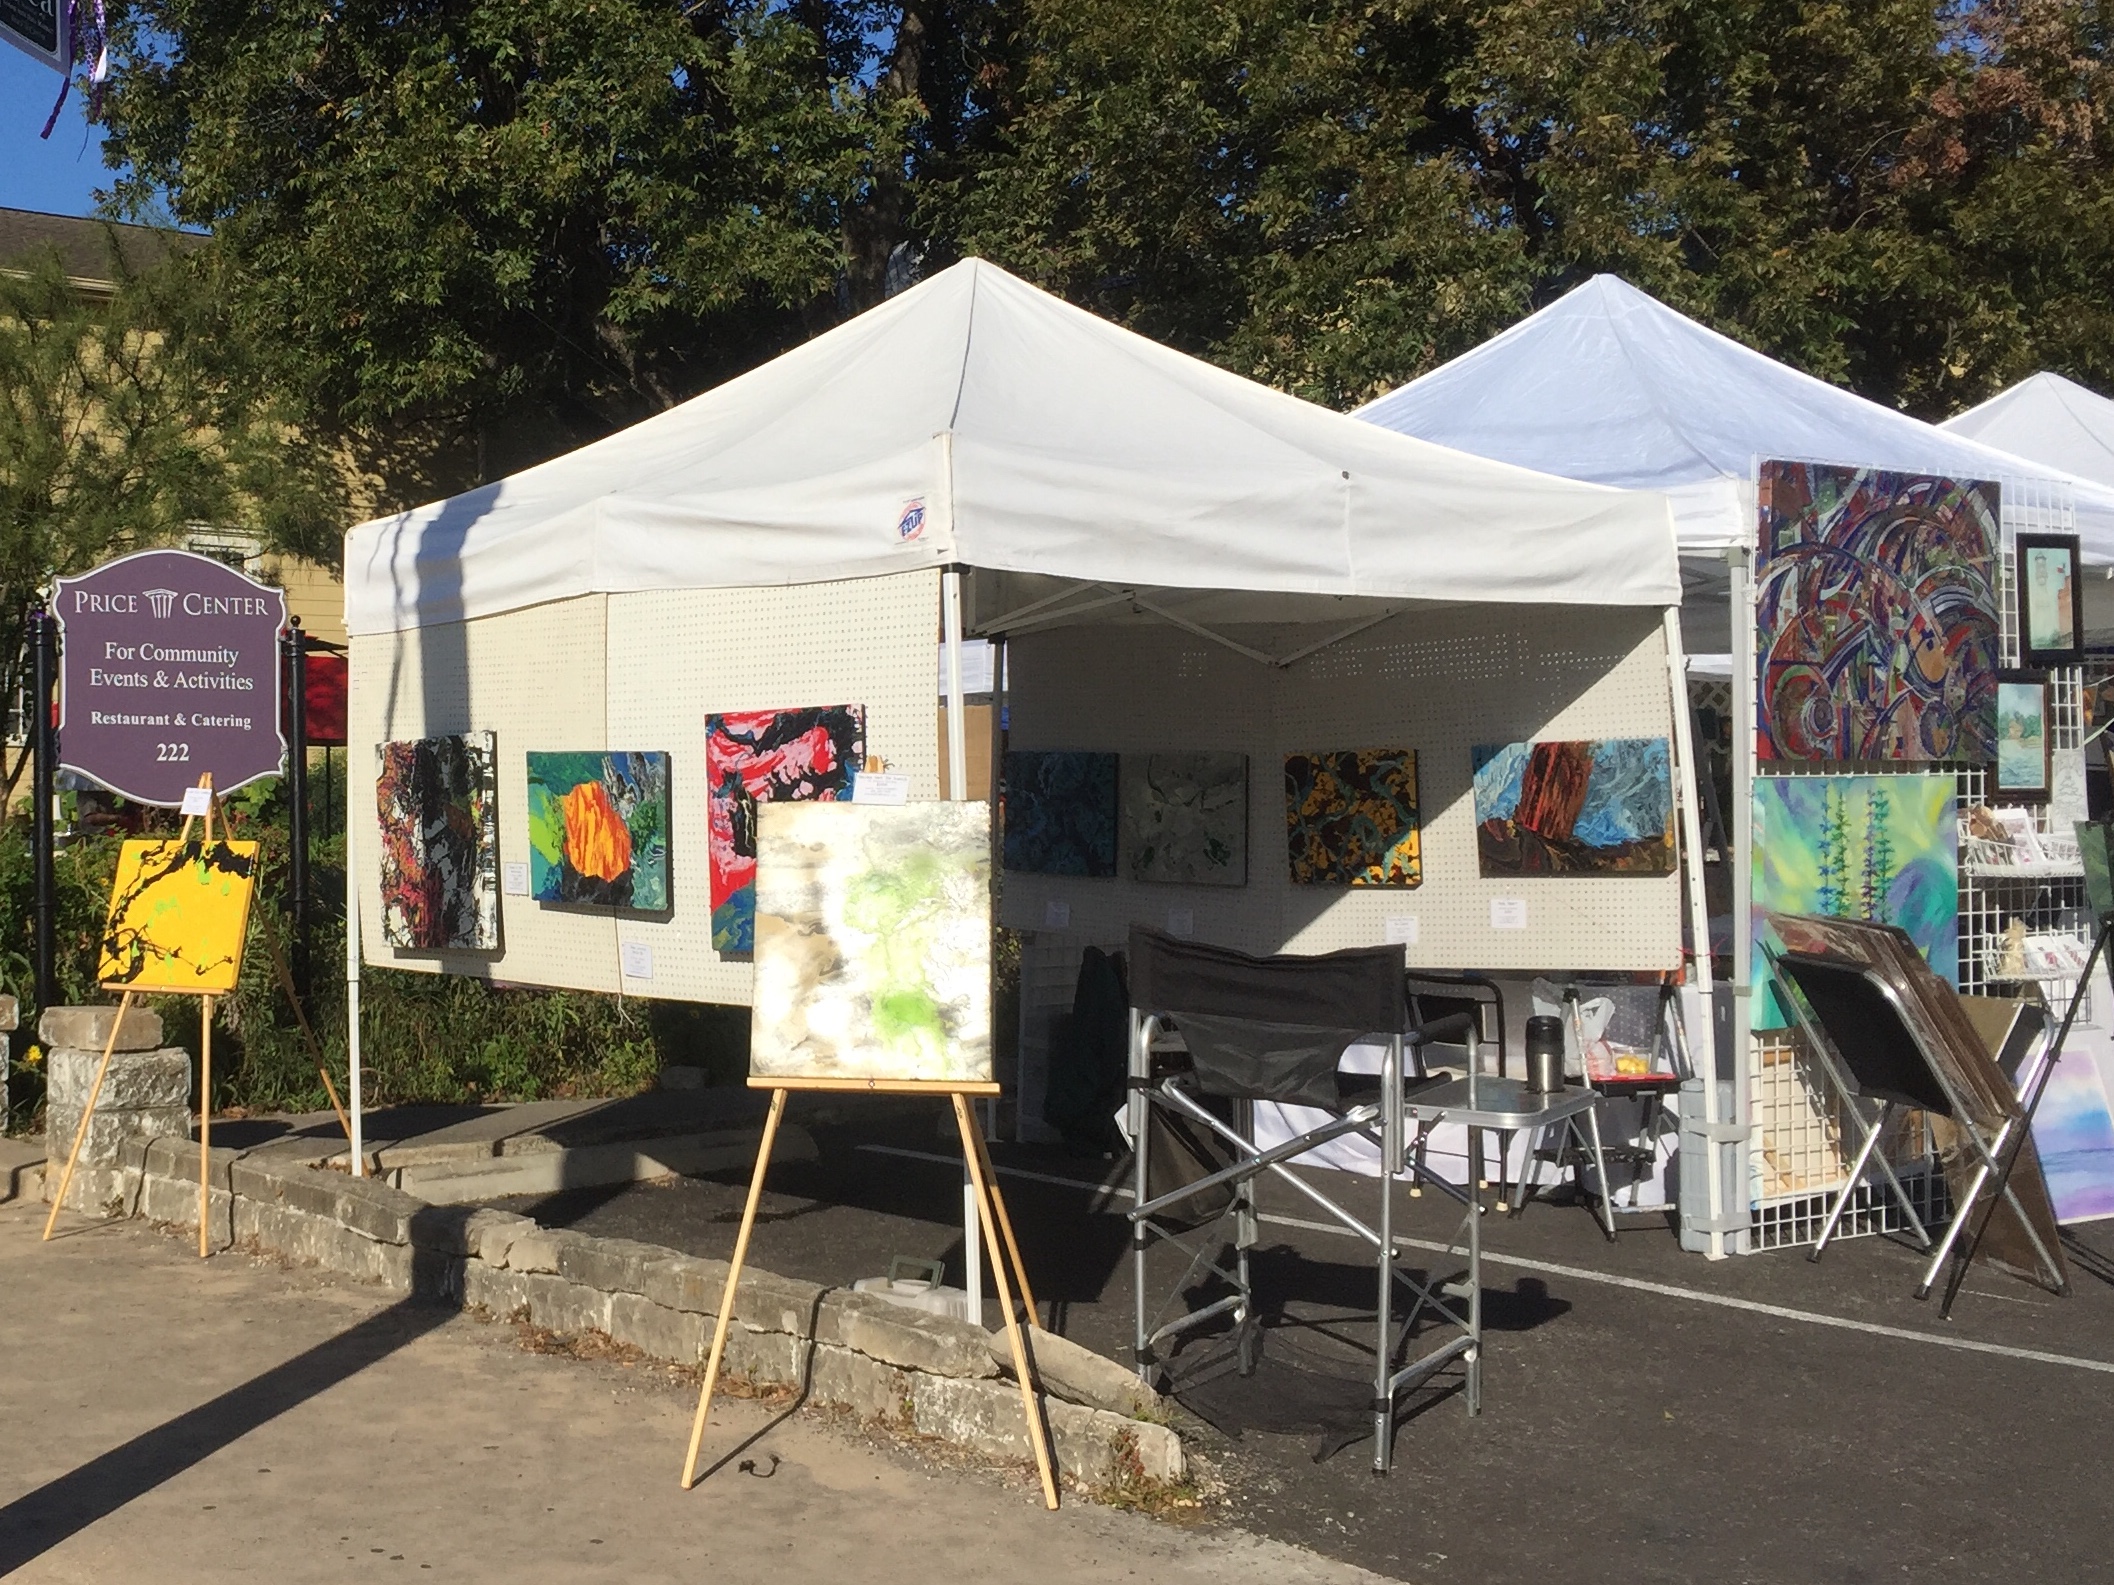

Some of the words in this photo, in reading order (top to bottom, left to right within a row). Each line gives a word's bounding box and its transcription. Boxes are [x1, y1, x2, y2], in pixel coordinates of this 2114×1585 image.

[74, 590, 138, 614] PRICE
[182, 592, 270, 616] CENTER
[104, 641, 136, 660] For
[139, 642, 239, 668] Community
[89, 668, 149, 688] Events
[152, 669, 170, 688] &
[173, 671, 254, 691] Activities
[90, 711, 170, 726] Restaurant
[173, 712, 187, 726] &
[191, 713, 252, 731] Catering
[156, 742, 190, 762] 222
